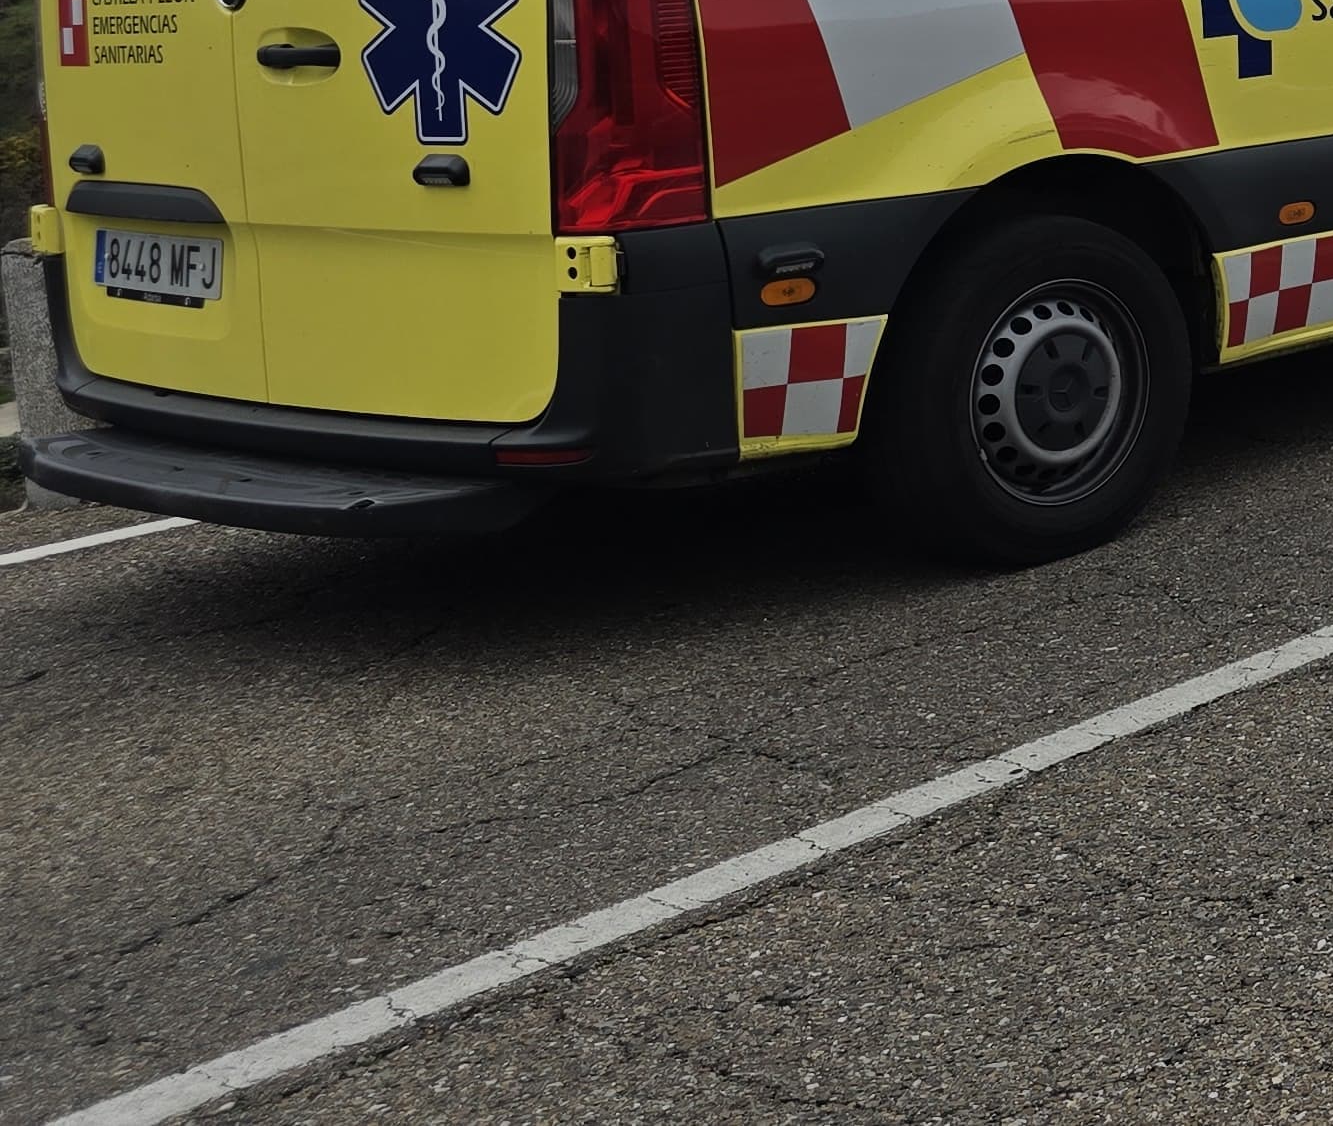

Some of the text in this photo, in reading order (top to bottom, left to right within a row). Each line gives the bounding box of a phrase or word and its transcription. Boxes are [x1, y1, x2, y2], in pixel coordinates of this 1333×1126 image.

[93, 14, 178, 35] EMERGENCIAS
[94, 44, 164, 64] SANITARIAS
[109, 238, 217, 290] 8448 MFJ
